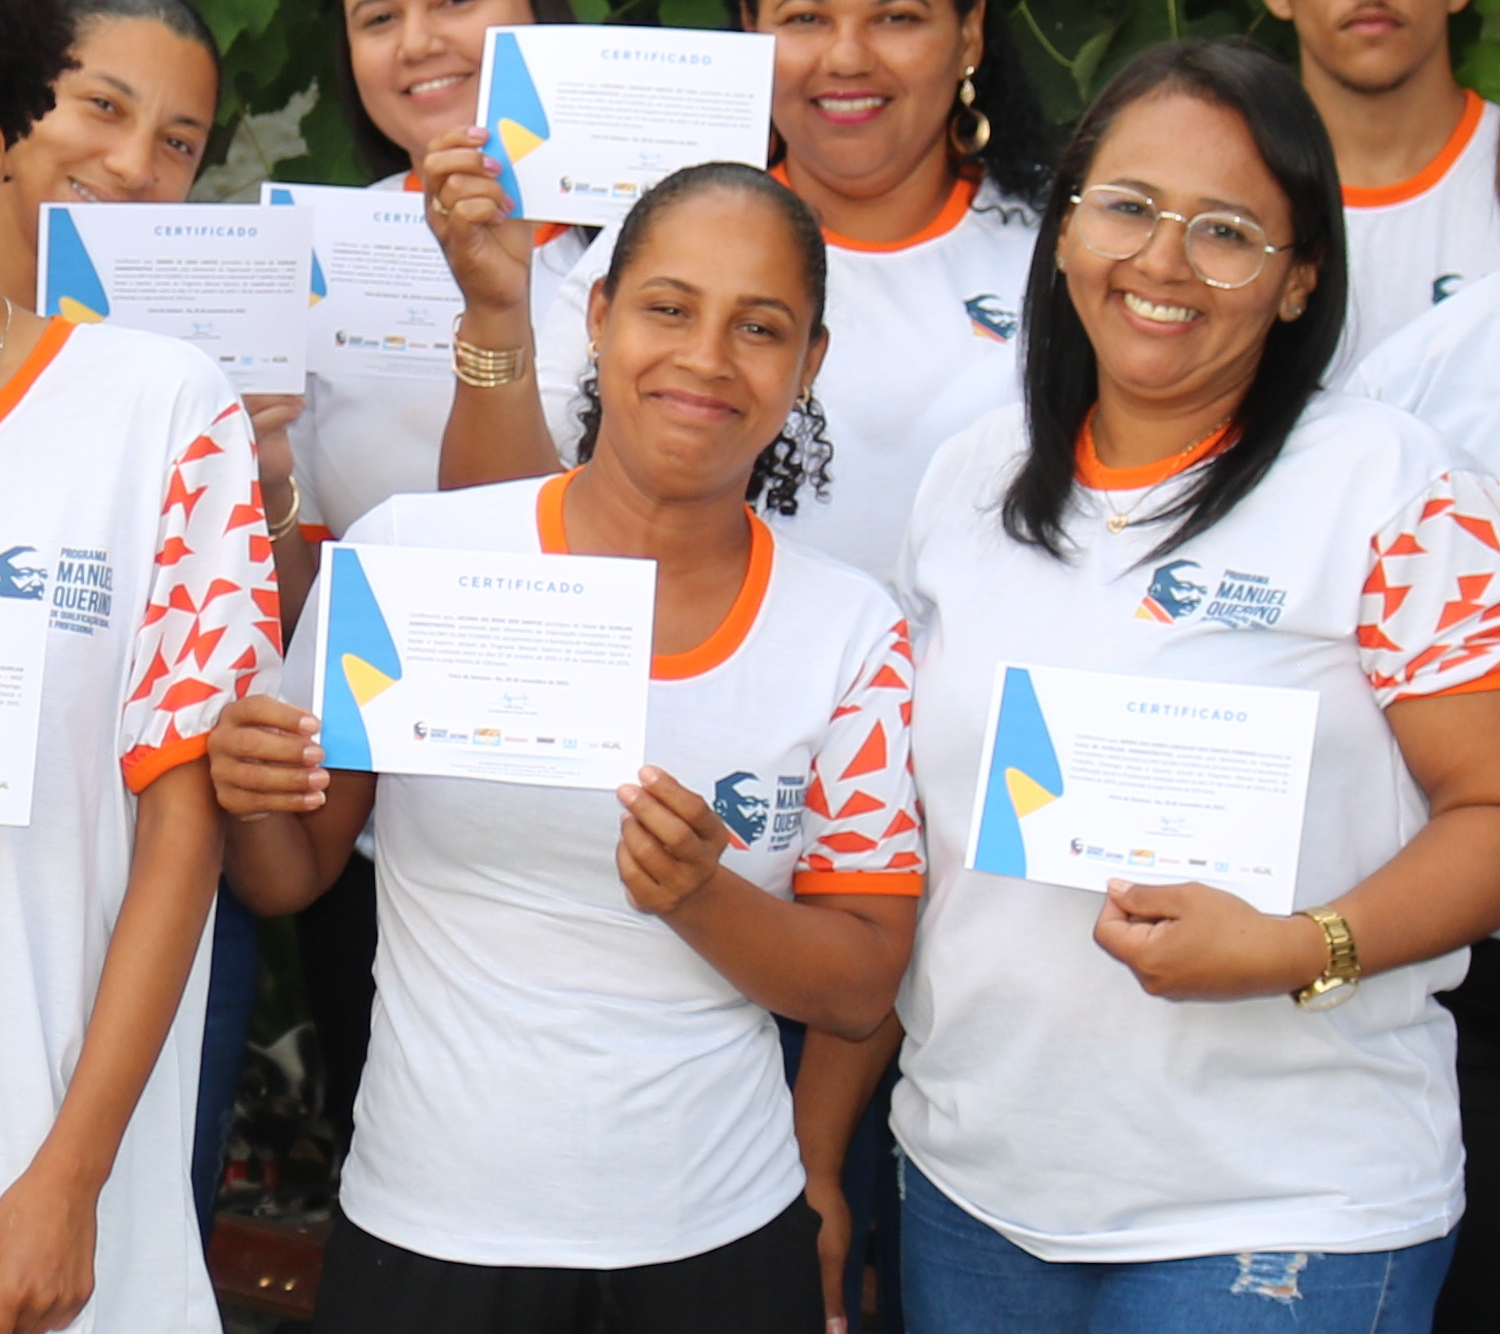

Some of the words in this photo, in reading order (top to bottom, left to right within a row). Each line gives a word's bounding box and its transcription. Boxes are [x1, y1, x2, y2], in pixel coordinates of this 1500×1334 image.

[601, 47, 713, 67] CERTIFICADO
[154, 224, 259, 238] CERTIFICADO
[57, 562, 113, 591] MANUEL
[458, 574, 585, 596] CERTIFICADO
[53, 586, 112, 616] QUERINO
[1214, 579, 1289, 607] MANUEL
[1126, 700, 1250, 724] CERTIFICADO
